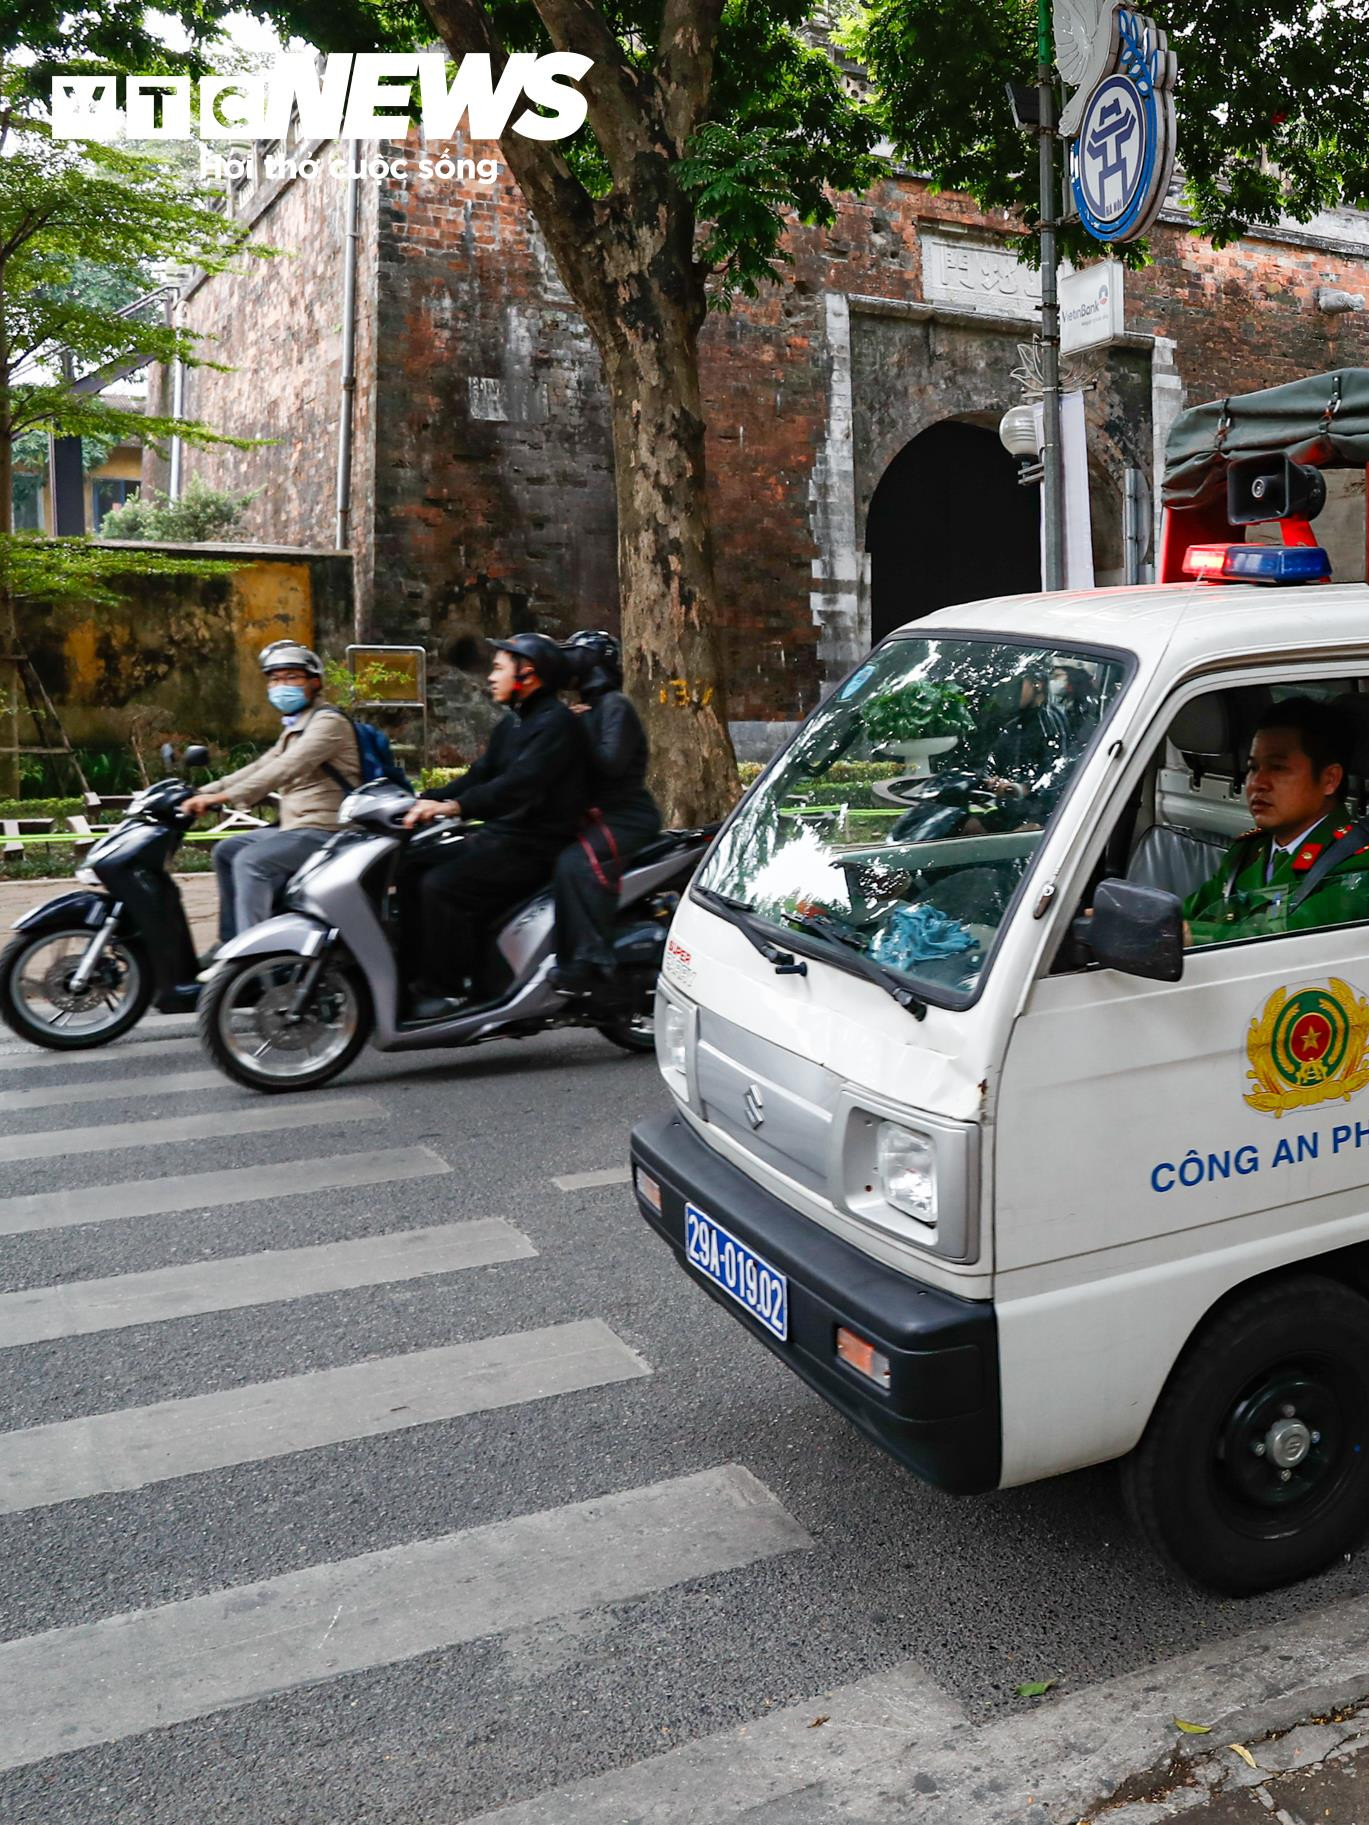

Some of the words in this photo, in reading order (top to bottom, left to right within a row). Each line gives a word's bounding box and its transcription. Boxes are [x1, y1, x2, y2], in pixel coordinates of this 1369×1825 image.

[1151, 1145, 1259, 1192] CÔNG
[1271, 1132, 1318, 1168] AN
[688, 1215, 783, 1330] 29A-019.02
